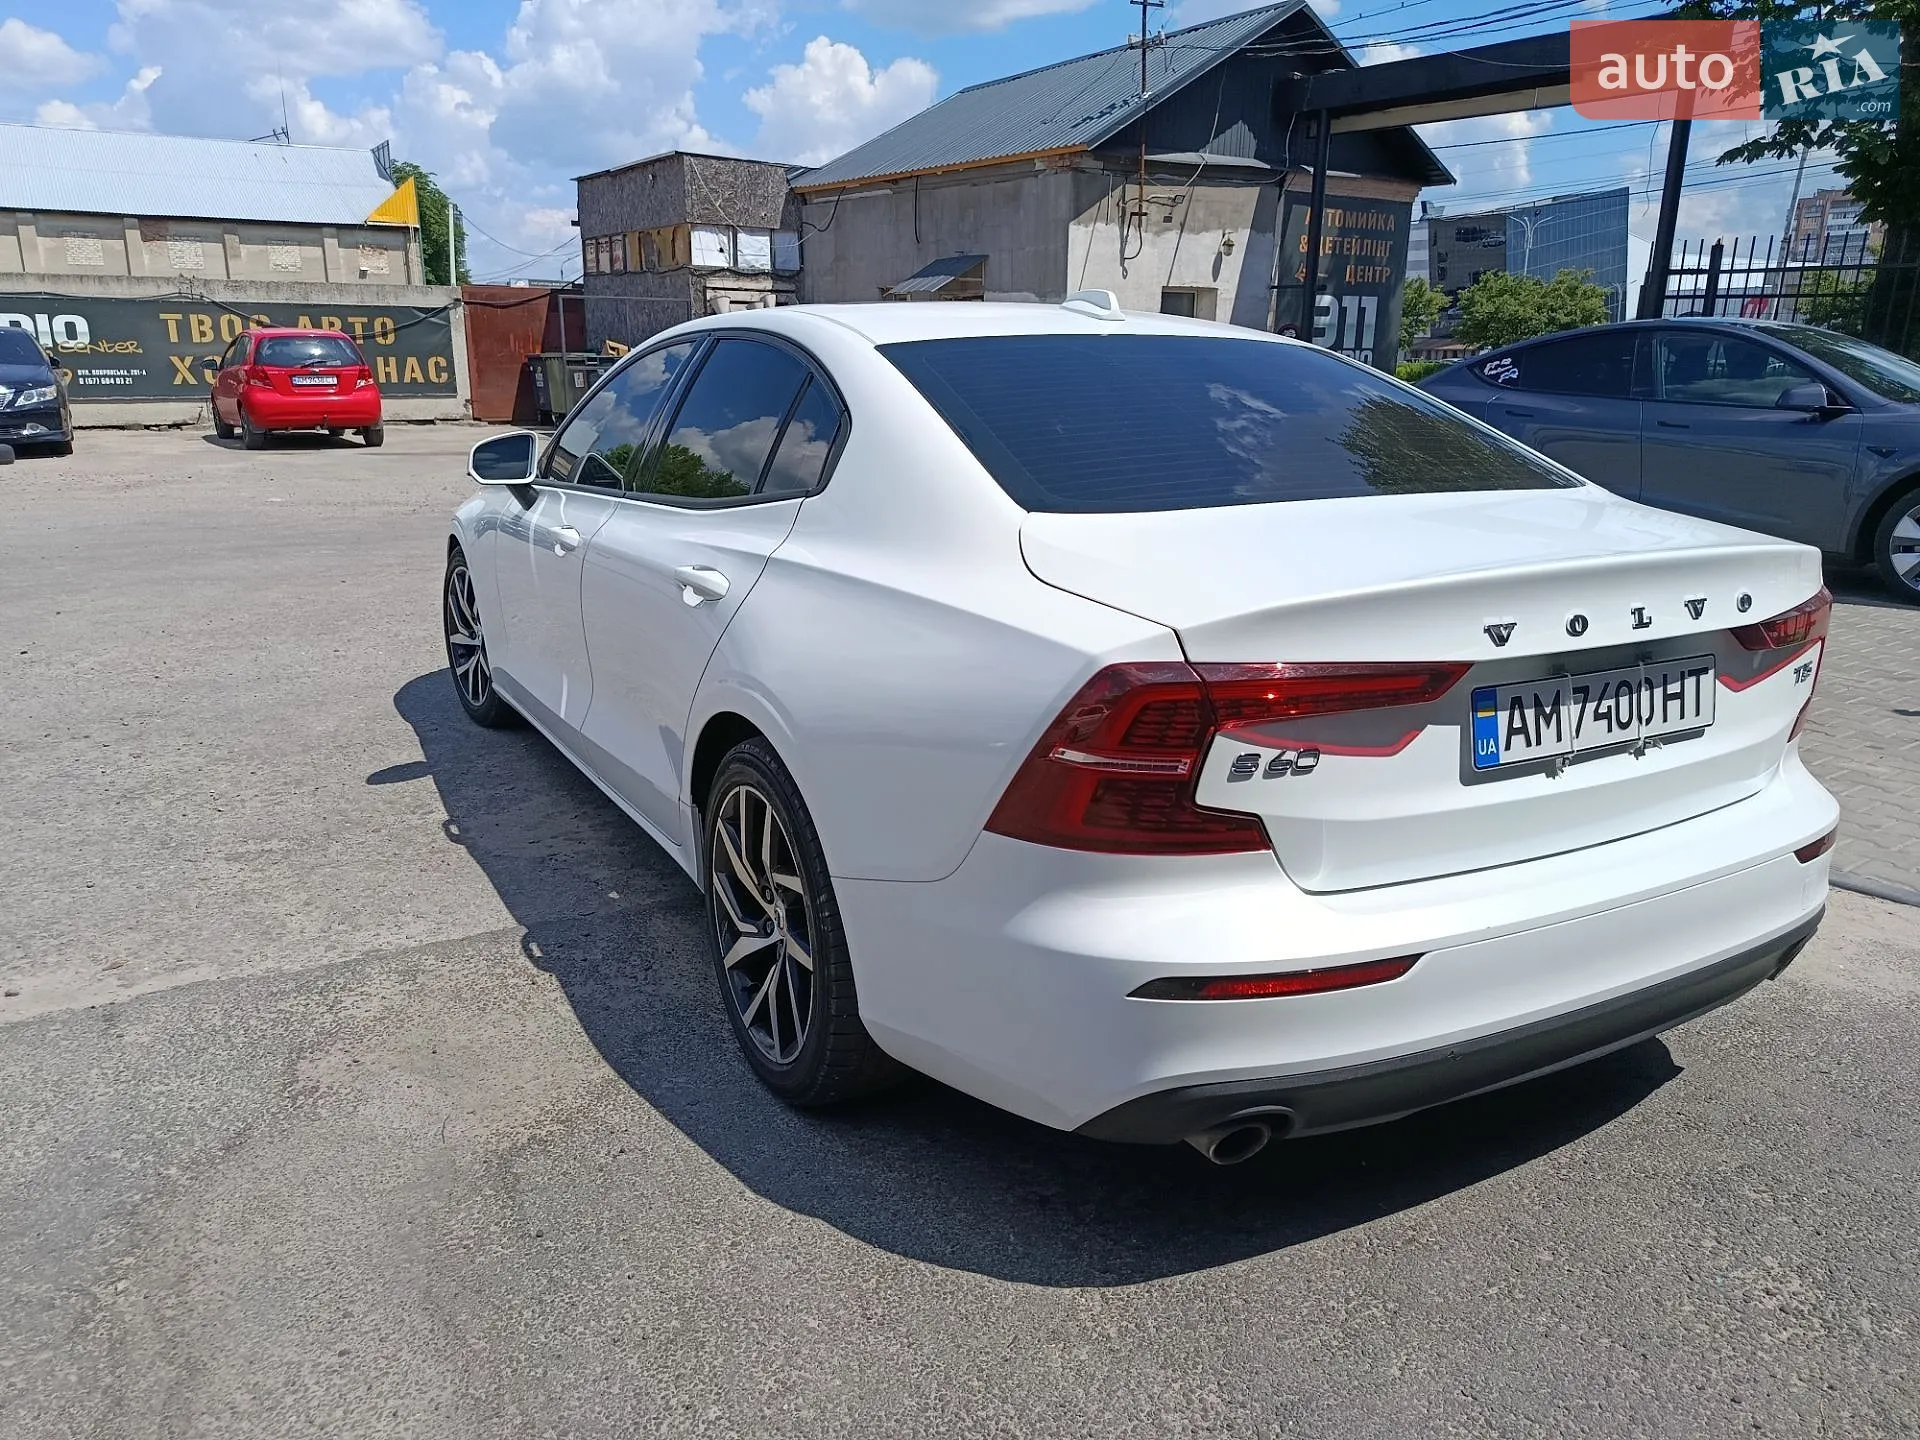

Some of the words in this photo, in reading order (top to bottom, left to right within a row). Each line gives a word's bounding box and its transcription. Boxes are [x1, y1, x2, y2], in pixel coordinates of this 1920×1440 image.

[1345, 264, 1391, 285] ЦЕНТР
[376, 355, 450, 384] НАС
[1483, 593, 1753, 648] VOLVO
[1478, 740, 1497, 755] UA
